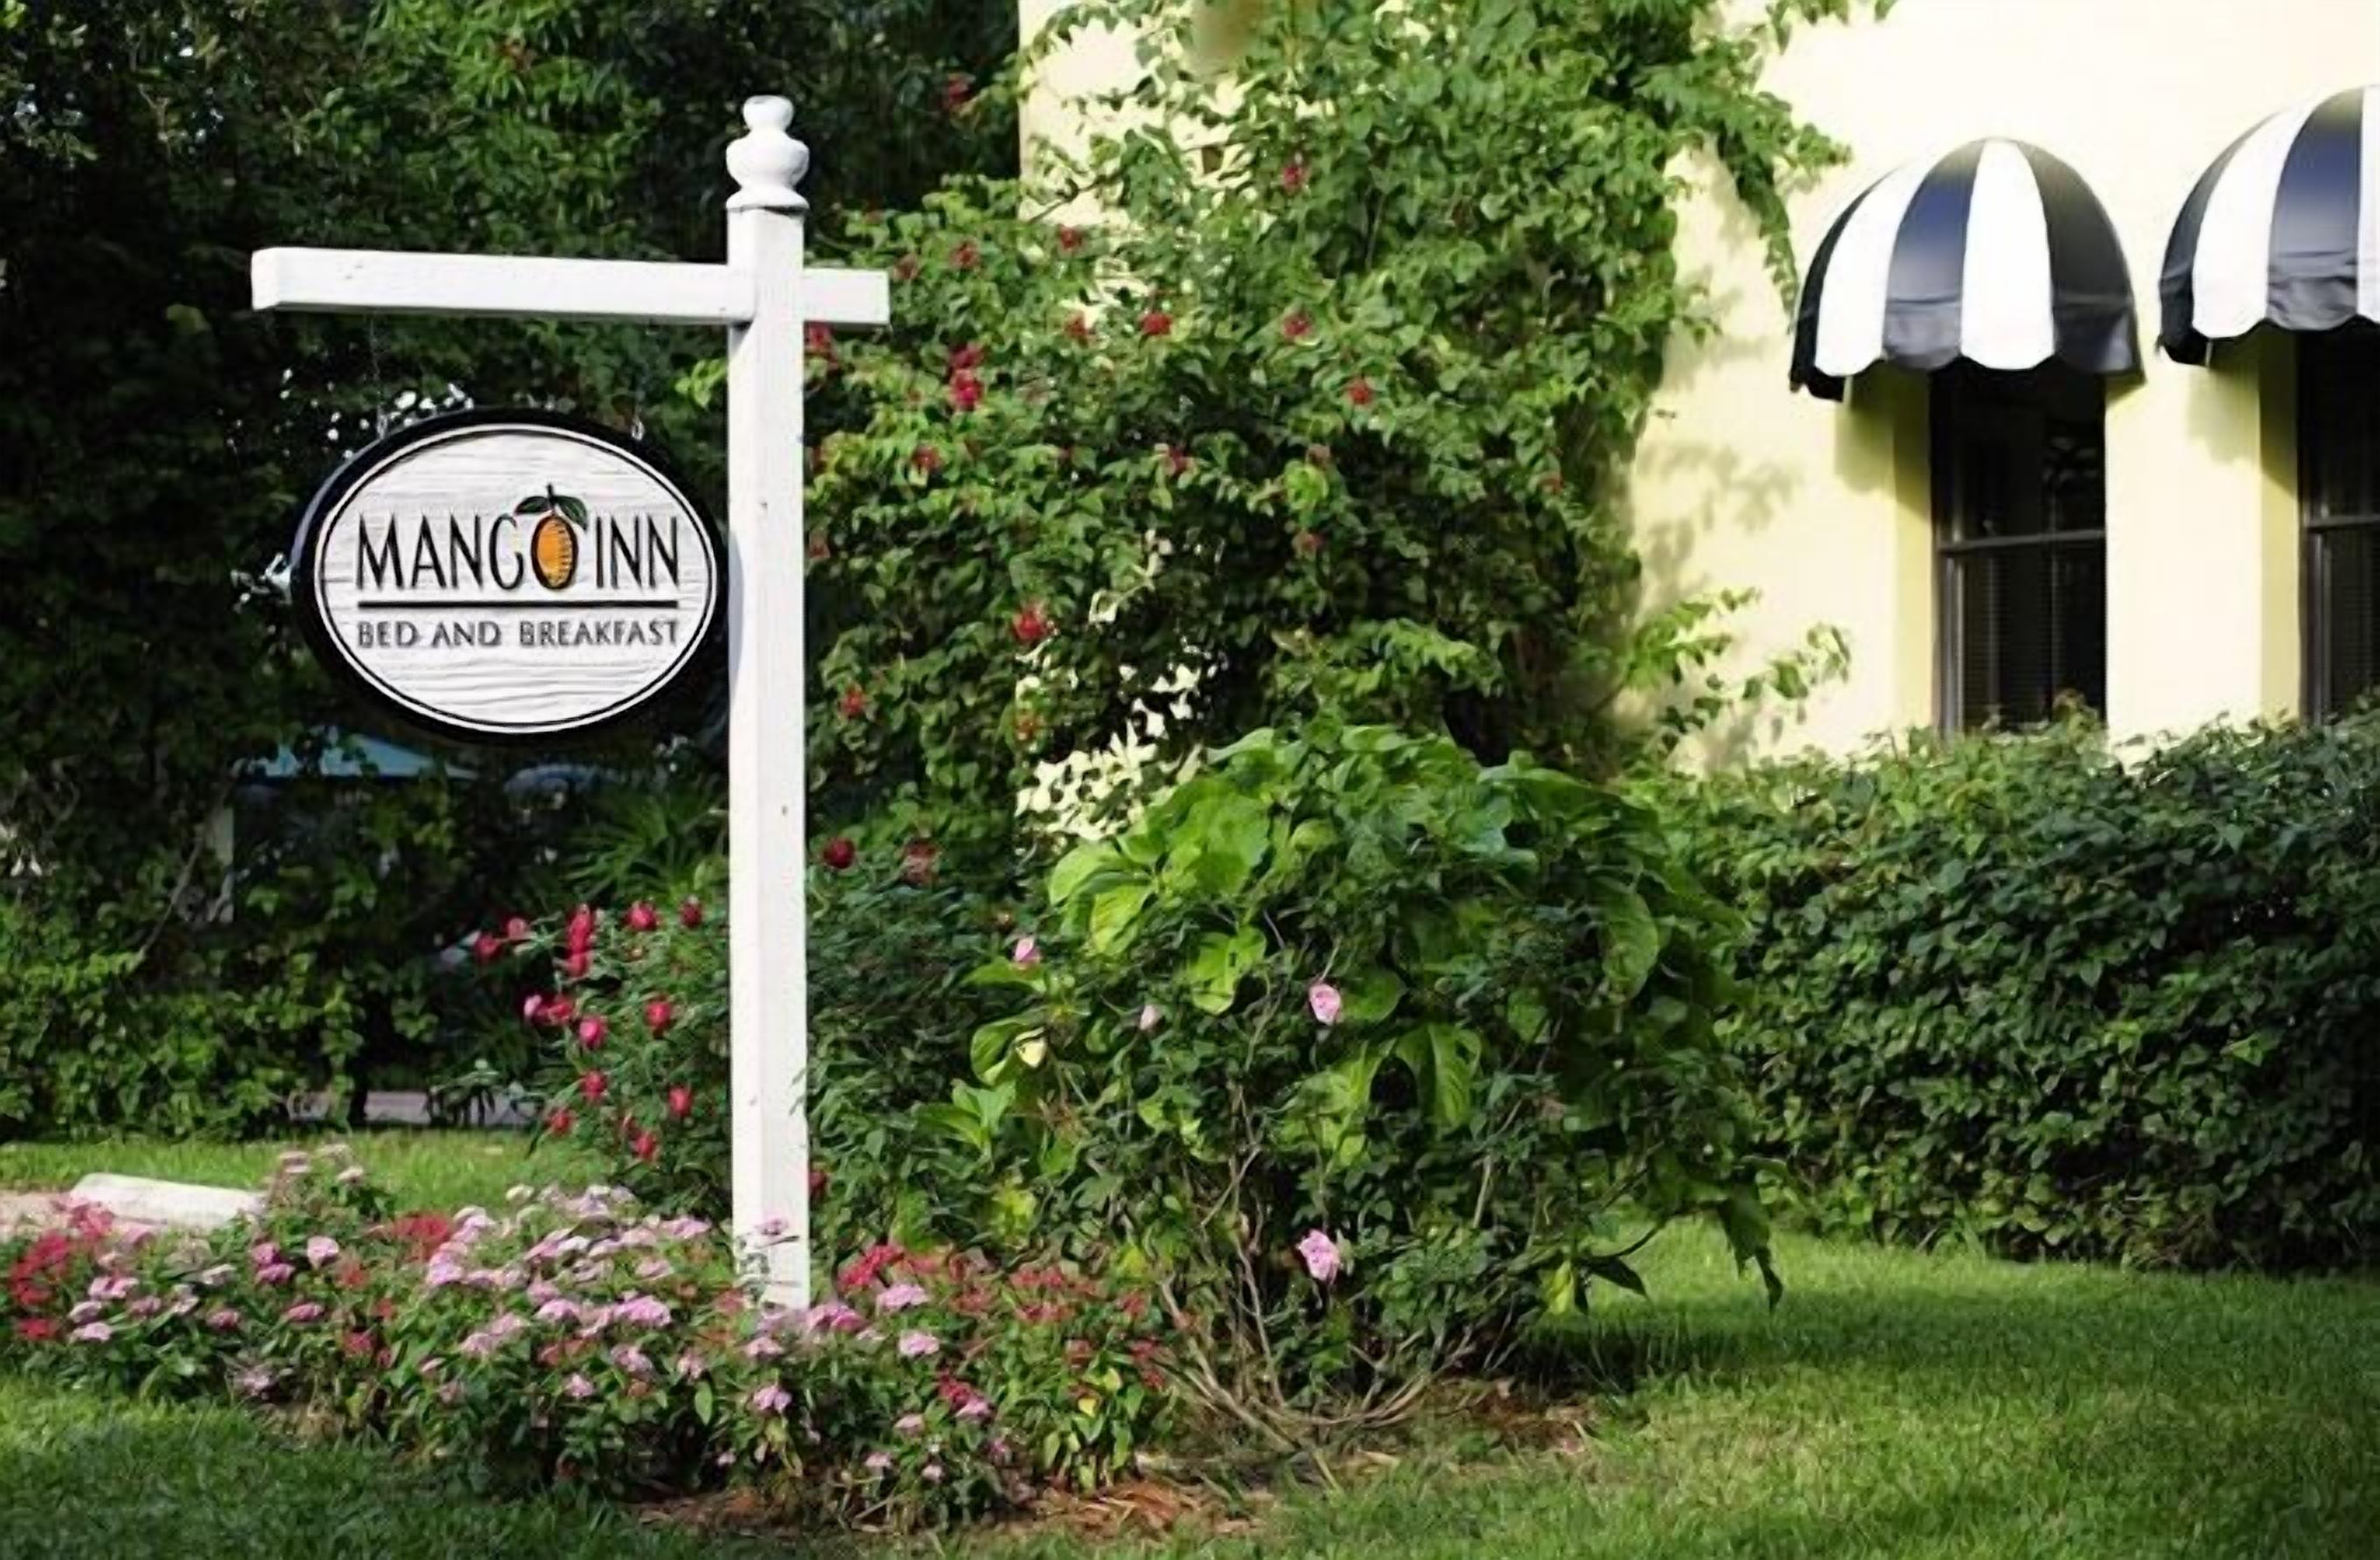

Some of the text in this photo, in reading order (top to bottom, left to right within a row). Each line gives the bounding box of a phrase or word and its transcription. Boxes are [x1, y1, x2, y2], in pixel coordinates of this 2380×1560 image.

[356, 512, 680, 591] MANGO INN
[357, 619, 679, 648] BED AND BREAKFAST
